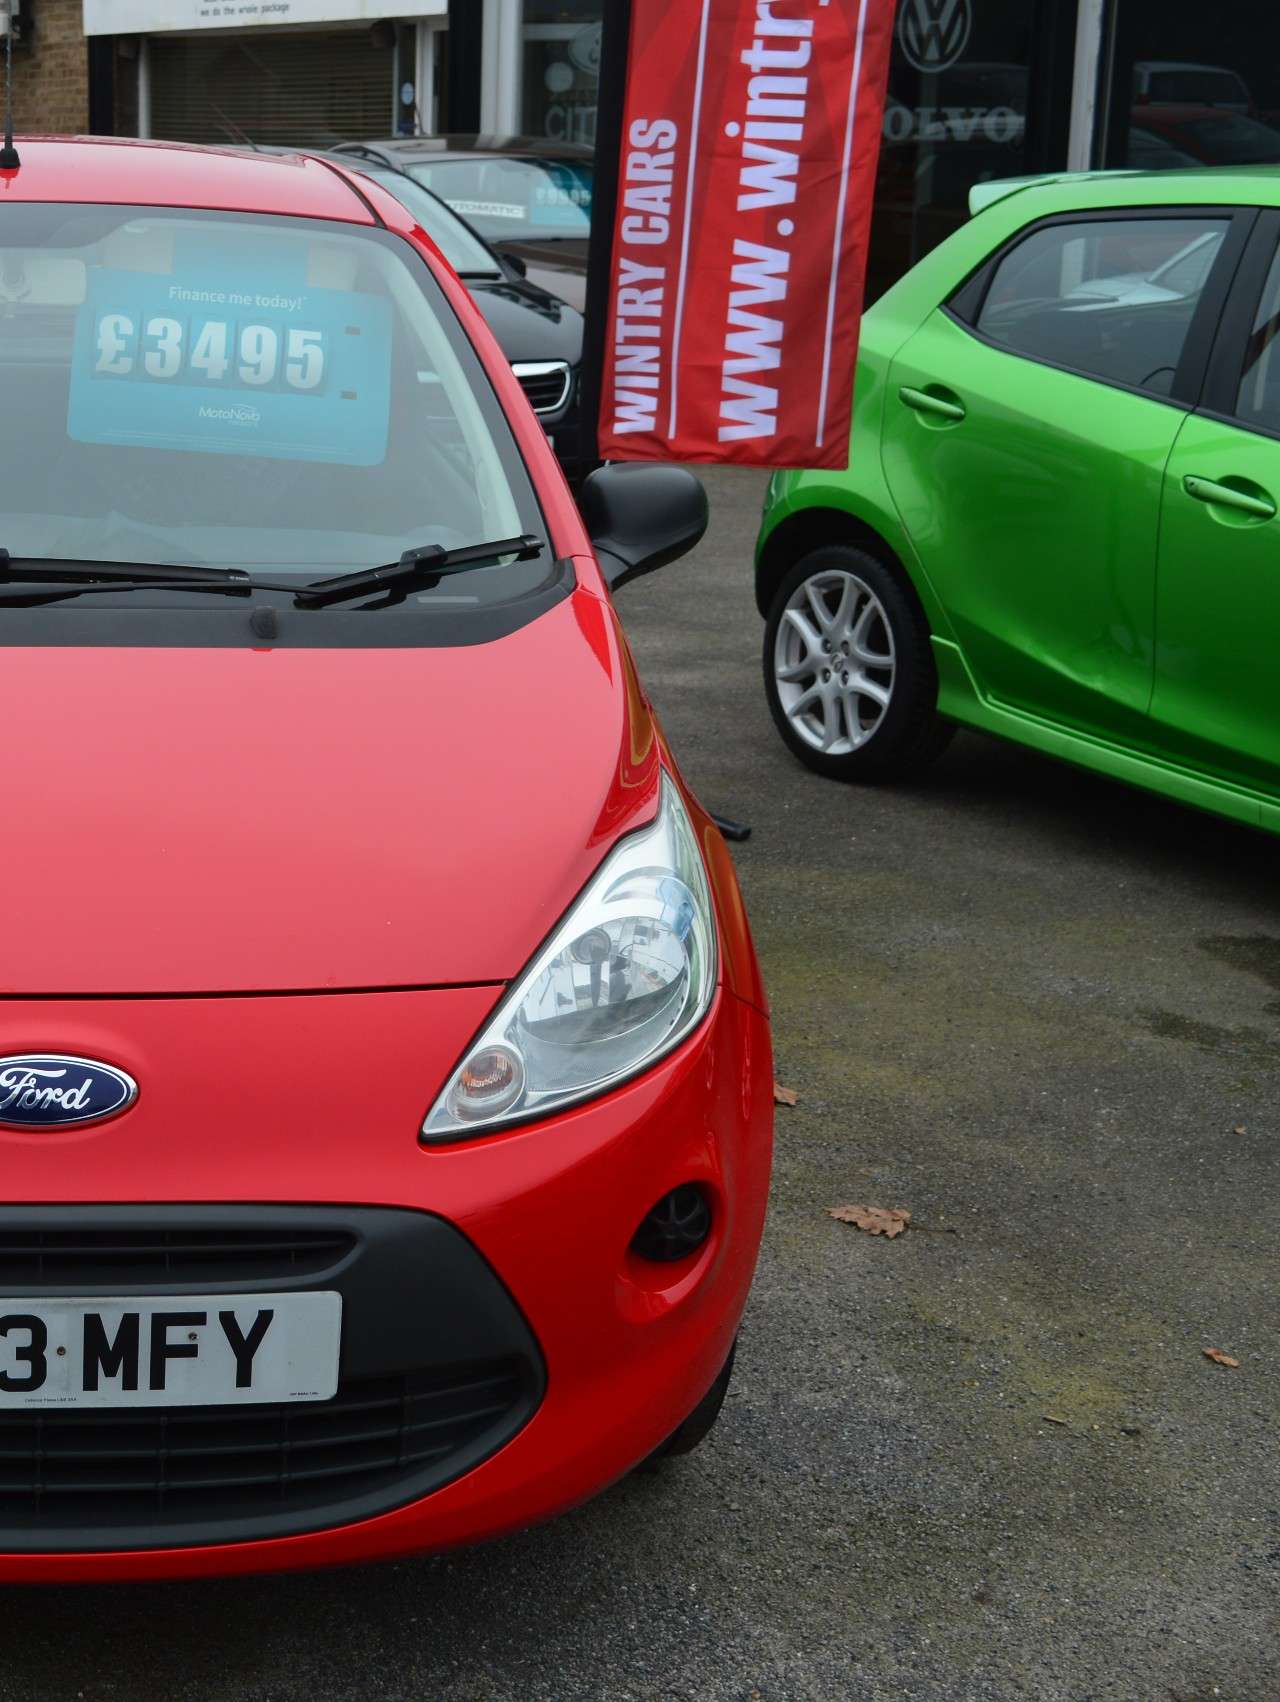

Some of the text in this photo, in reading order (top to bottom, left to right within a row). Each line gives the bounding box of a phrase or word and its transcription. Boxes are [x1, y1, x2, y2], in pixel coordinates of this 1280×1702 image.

[545, 106, 598, 143] CIT
[882, 106, 1022, 142] OLVO
[718, 0, 830, 442] www.wintr
[168, 286, 226, 303] Finance
[229, 291, 251, 306] me
[612, 118, 678, 435] WINTRY CARS
[95, 314, 325, 389] £3495
[82, 1309, 275, 1392] MFY
